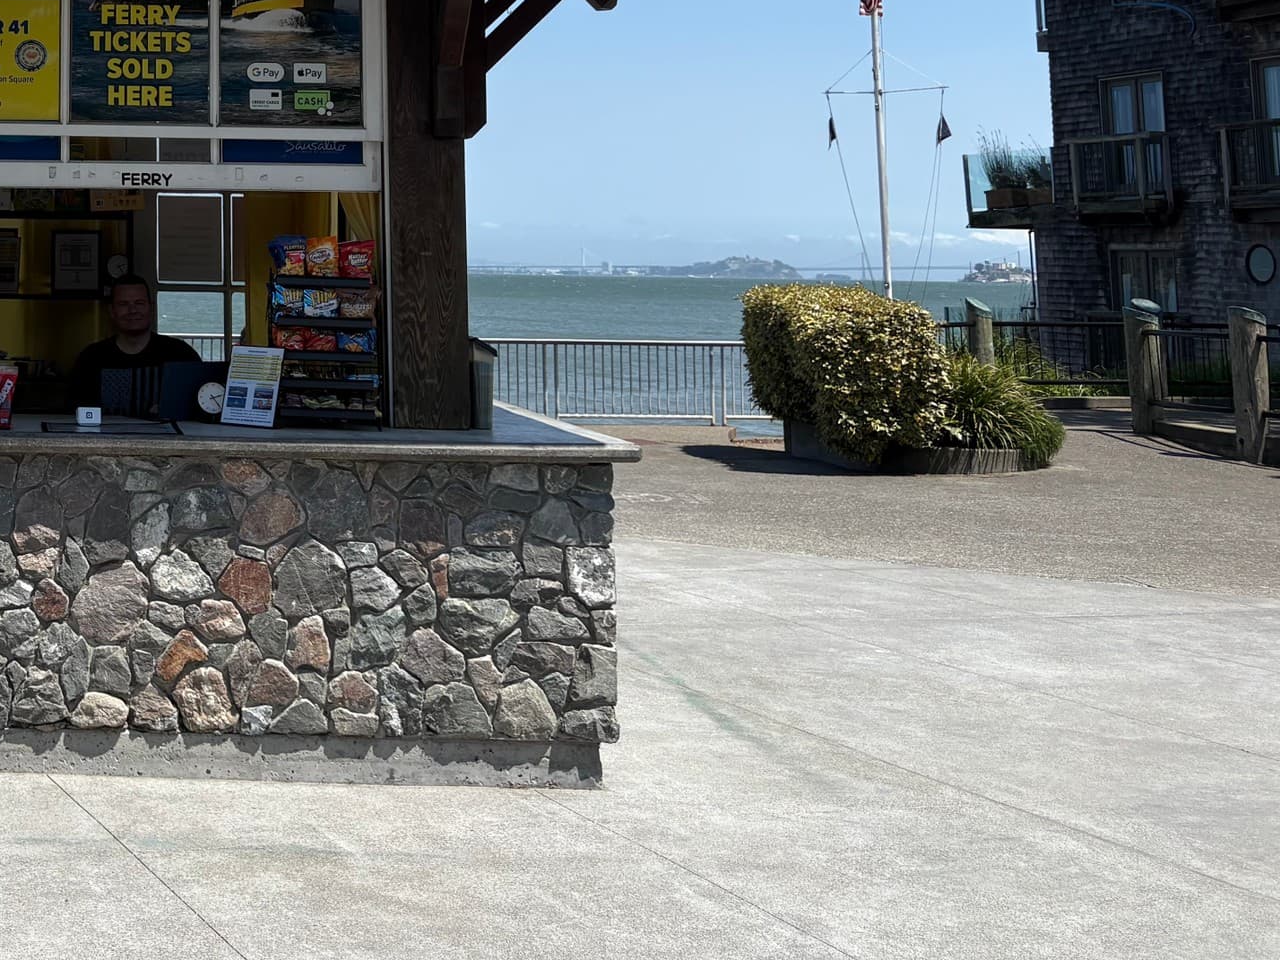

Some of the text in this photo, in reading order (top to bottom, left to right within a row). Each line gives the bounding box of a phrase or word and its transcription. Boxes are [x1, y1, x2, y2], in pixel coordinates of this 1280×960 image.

[100, 4, 181, 26] FERRY
[9, 20, 29, 34] 41
[89, 31, 192, 53] TICKETS
[106, 58, 174, 79] SOLD
[252, 68, 280, 79] G Pay
[305, 68, 322, 79] Pay
[8, 76, 34, 84] Square
[107, 84, 174, 107] HERE
[121, 172, 173, 187] FERRY
